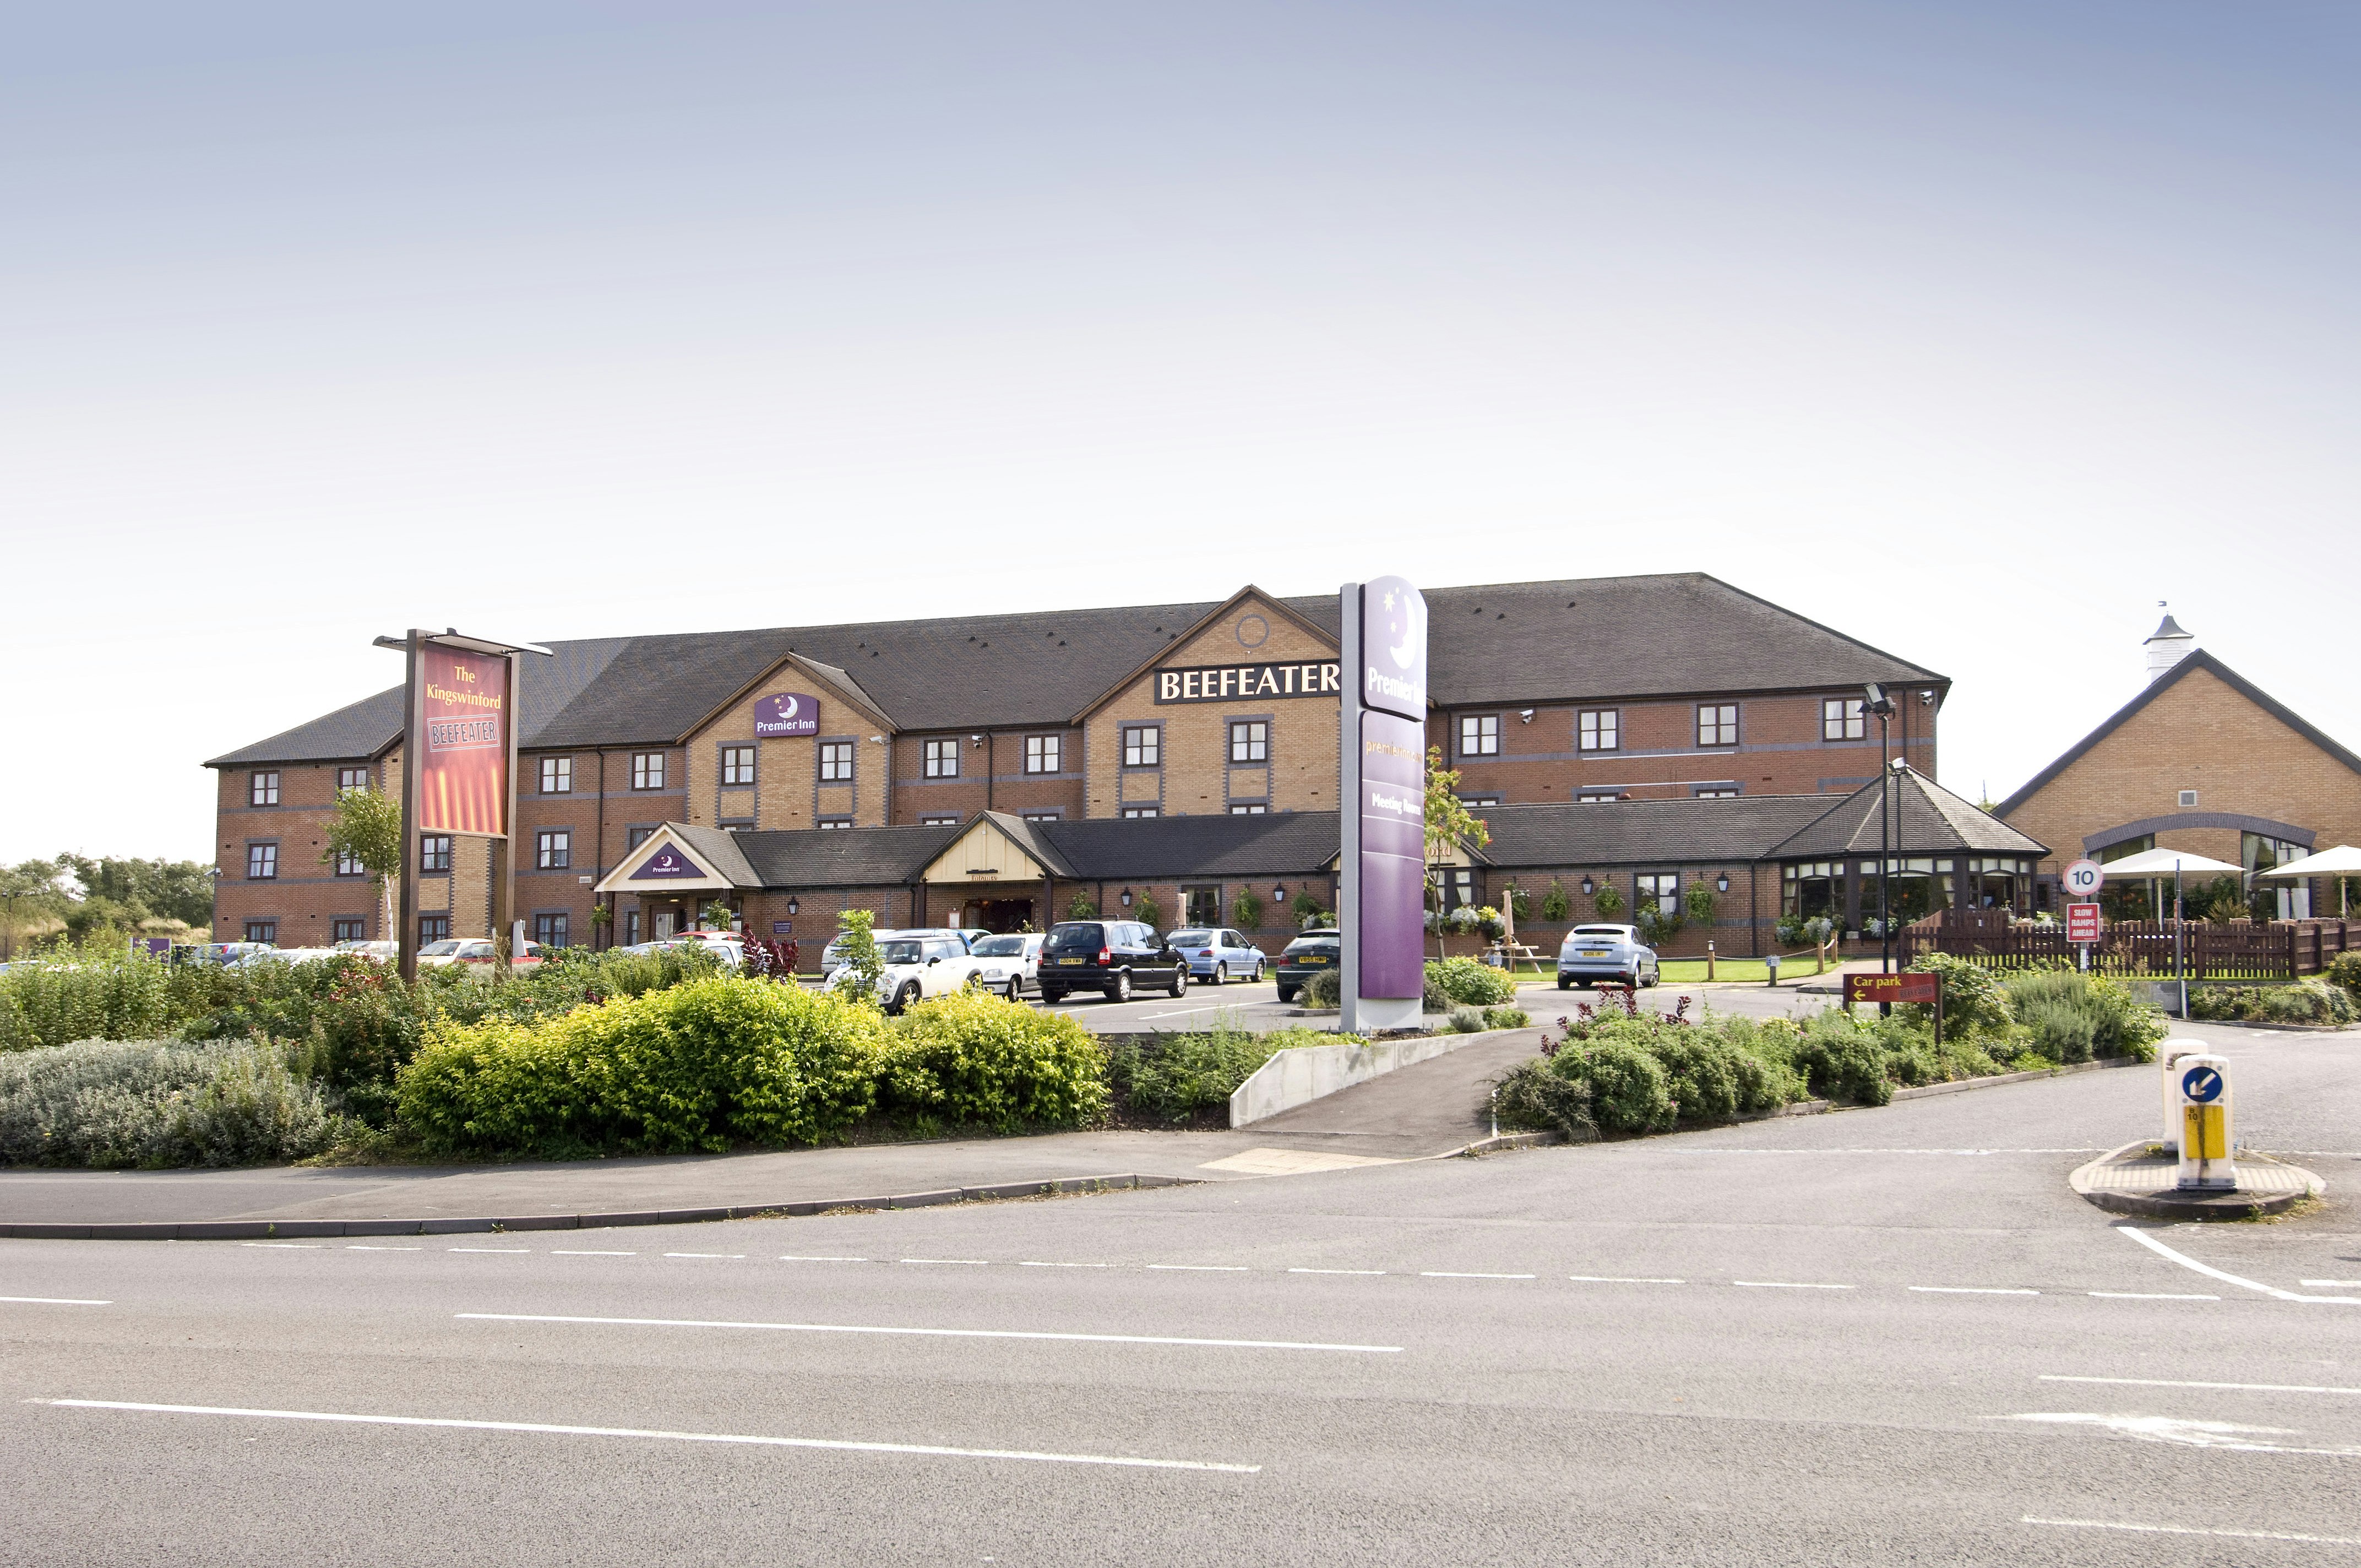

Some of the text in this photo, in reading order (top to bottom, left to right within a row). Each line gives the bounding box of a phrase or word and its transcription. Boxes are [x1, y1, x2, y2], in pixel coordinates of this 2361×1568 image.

[454, 666, 475, 683] The
[1161, 663, 1340, 700] BEEFEATER
[1368, 666, 1413, 702] Premier
[427, 684, 501, 709] Kingswinford
[431, 721, 497, 746] BEEFEATER
[757, 719, 815, 732] Premier Inn
[1366, 741, 1423, 765] premierinn.com
[1372, 792, 1421, 816] Meeting Rooms
[2072, 870, 2094, 885] 10
[1853, 975, 1902, 989] Car park
